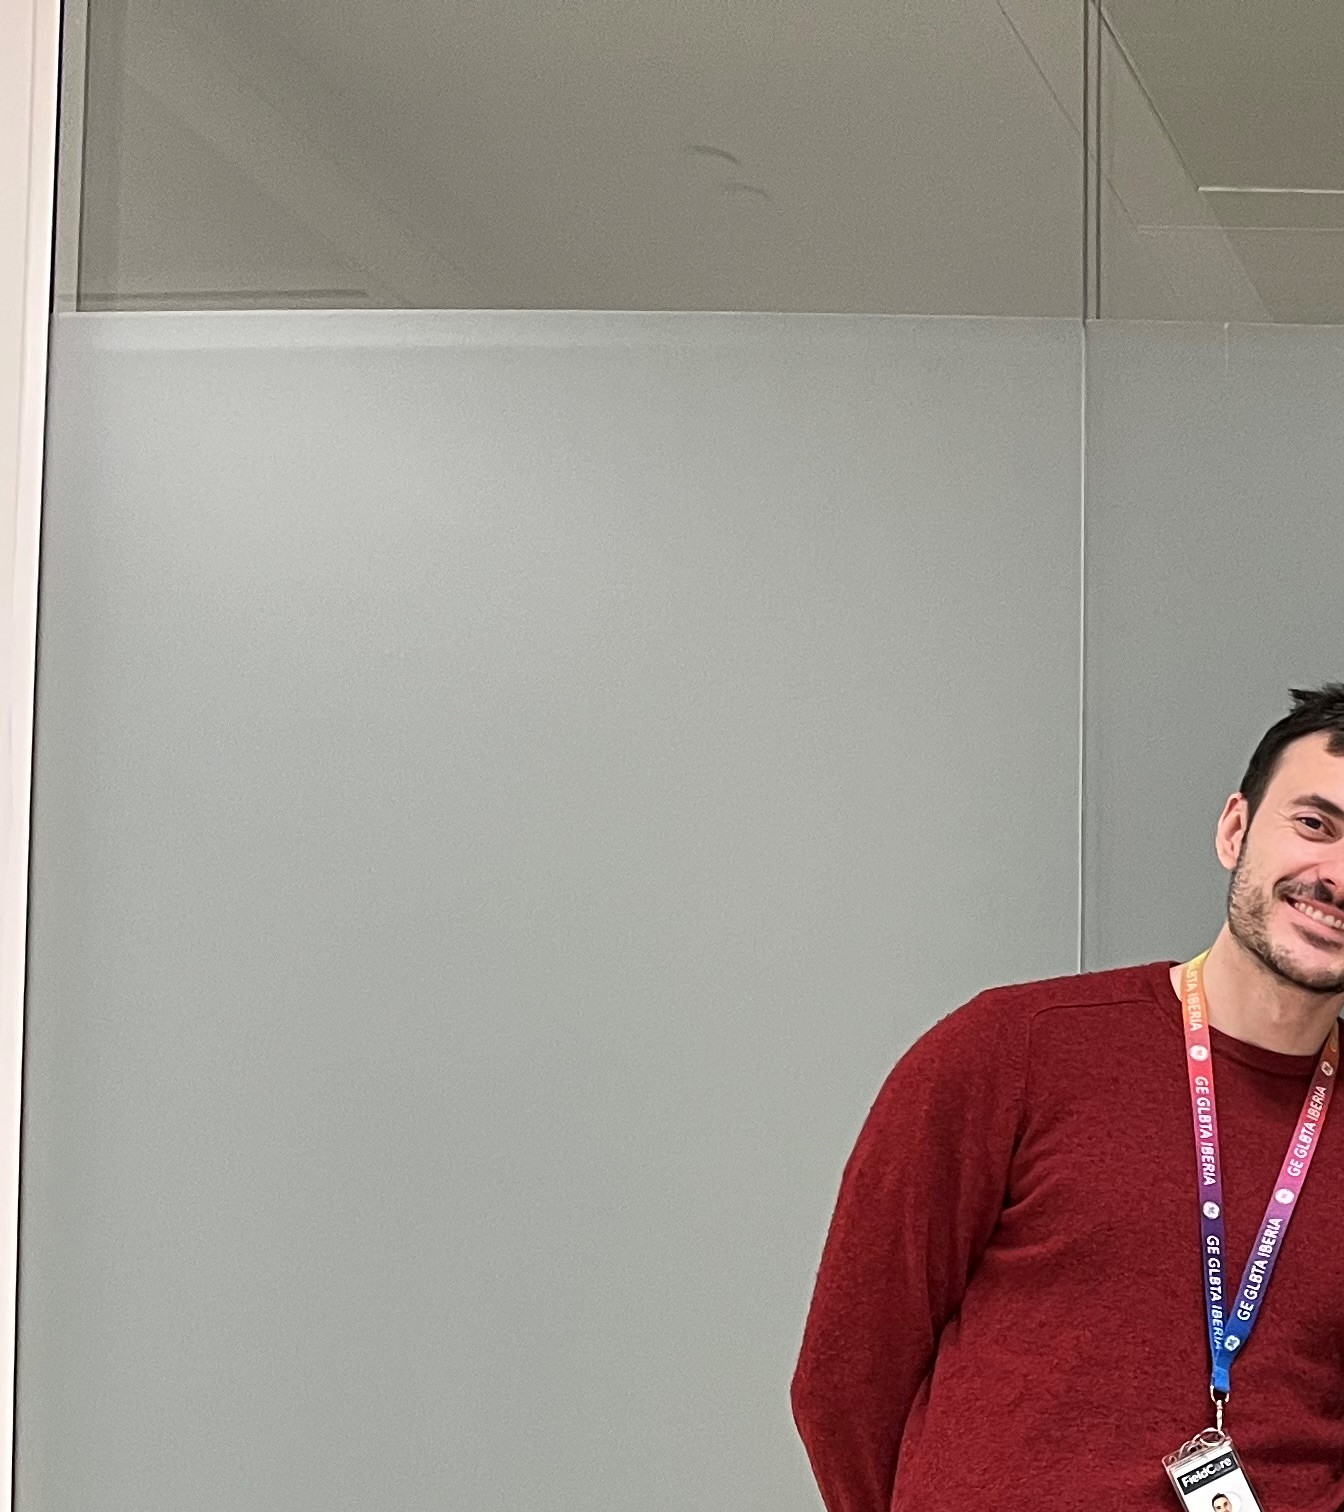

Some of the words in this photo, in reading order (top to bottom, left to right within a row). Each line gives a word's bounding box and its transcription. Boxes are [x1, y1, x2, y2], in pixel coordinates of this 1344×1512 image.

[1187, 992, 1203, 1032] IBERIA
[1195, 1076, 1209, 1095] GE
[1306, 1086, 1327, 1121] IBERIA
[1196, 1097, 1213, 1139] GLBTA
[1293, 1122, 1316, 1159] GLBTA
[1200, 1142, 1216, 1186] IBERIA
[1287, 1158, 1304, 1177] GE
[1206, 1235, 1220, 1255] GE
[1257, 1218, 1283, 1257] IBERIA
[1207, 1257, 1222, 1301] GLBTA
[1243, 1260, 1268, 1300] GLBTA
[1237, 1300, 1254, 1320] GE
[1181, 1457, 1232, 1488] FieldCore
